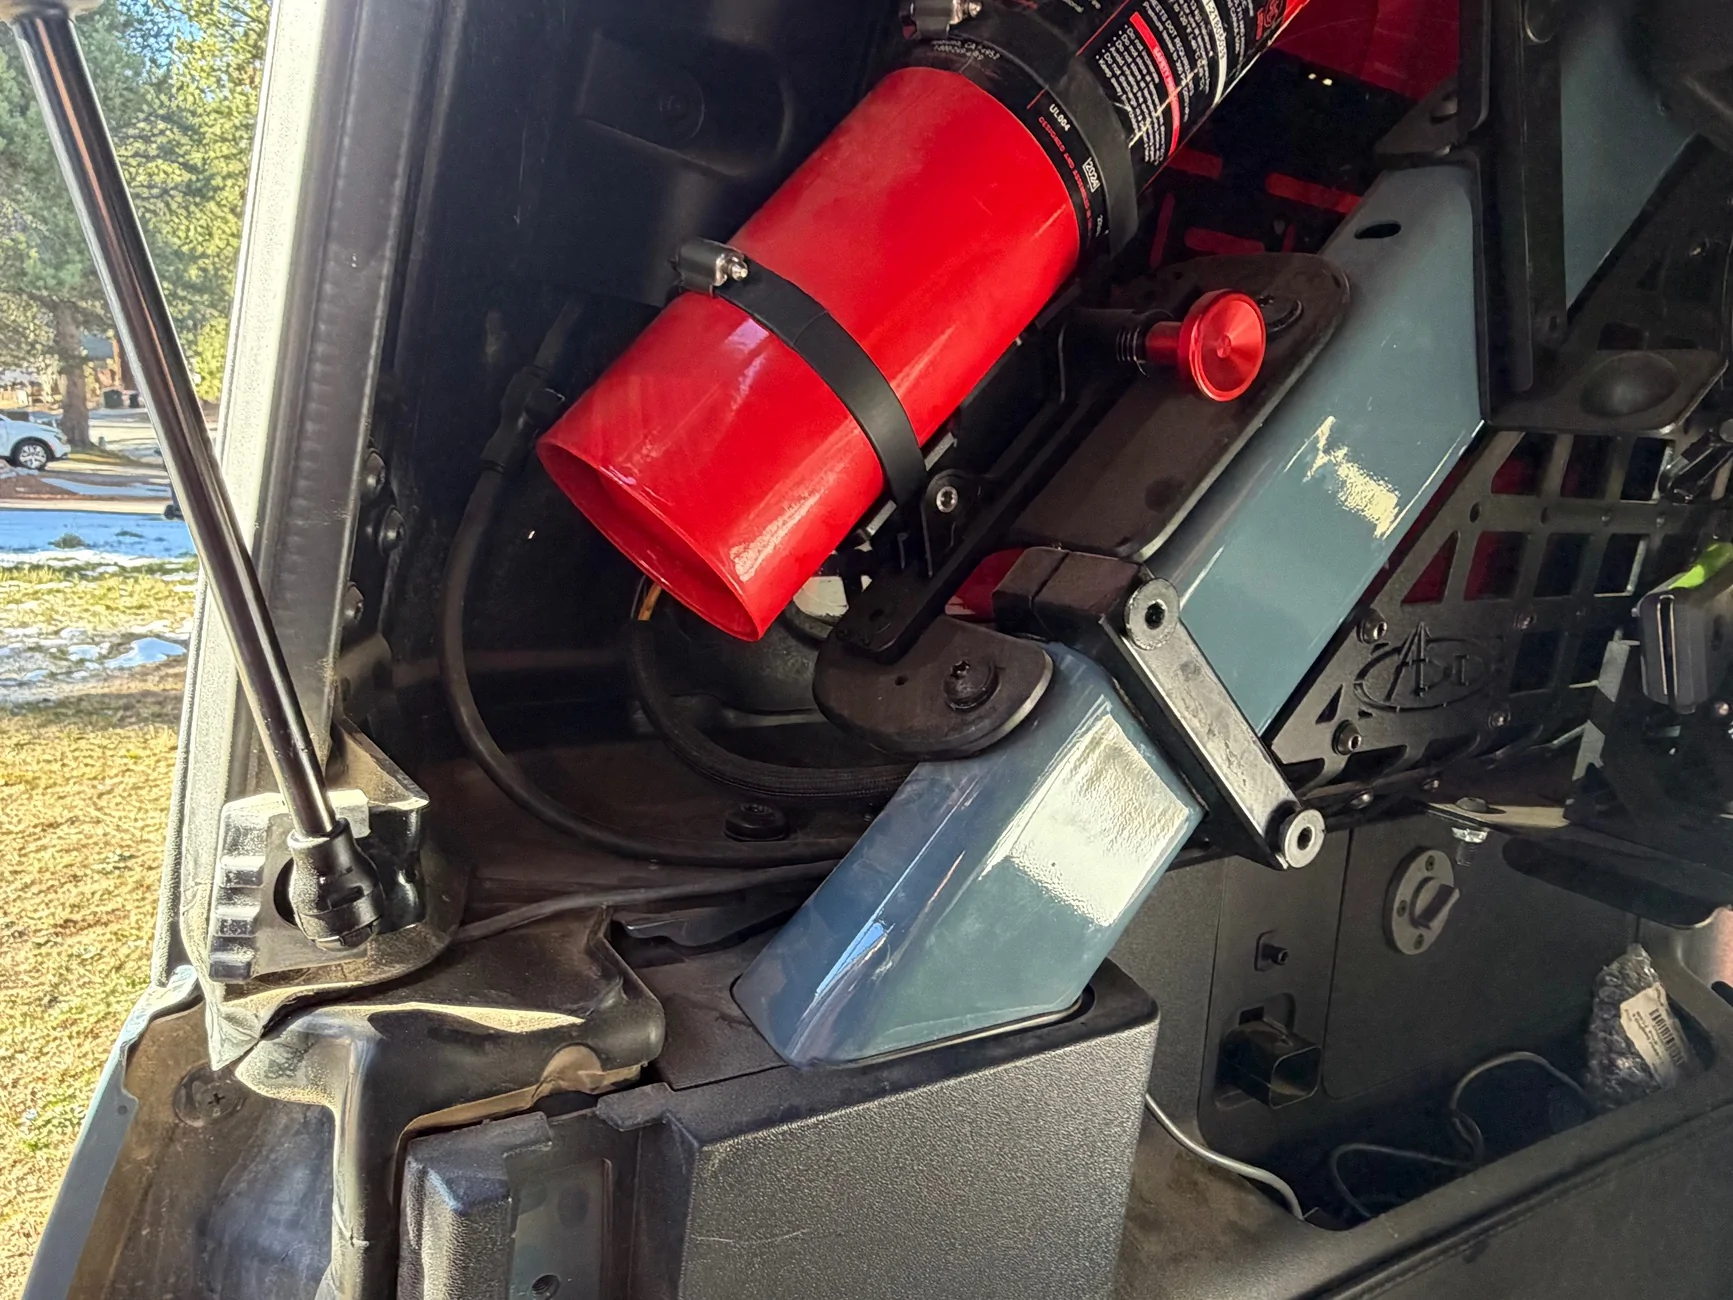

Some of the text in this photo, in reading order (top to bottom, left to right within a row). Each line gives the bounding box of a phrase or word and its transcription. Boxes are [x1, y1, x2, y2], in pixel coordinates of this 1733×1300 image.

[1143, 1, 1163, 31] Pressure
[1173, 51, 1178, 60] to
[1165, 20, 1178, 37] DOT
[1173, 3, 1180, 12] to
[1179, 11, 1188, 26] 120
[1121, 34, 1130, 46] Do
[1129, 45, 1138, 57] not
[1136, 57, 1147, 74] store
[1127, 27, 1136, 39] Do
[1134, 39, 1143, 51] not
[1098, 58, 1112, 77] Keep
[1111, 77, 1123, 96] away
[1104, 52, 1112, 64] Do
[1112, 63, 1121, 76] not
[1119, 76, 1137, 107] discharge
[1109, 47, 1124, 66] Avoid
[1123, 64, 1139, 93] inhaling
[1115, 40, 1124, 52] Do
[1123, 51, 1132, 63] not
[1130, 62, 1141, 81] store
[1049, 104, 1070, 132] UL004
[1039, 116, 1065, 152] DESIGNED
[1064, 152, 1075, 169] AND
[1086, 160, 1099, 188] 2024
